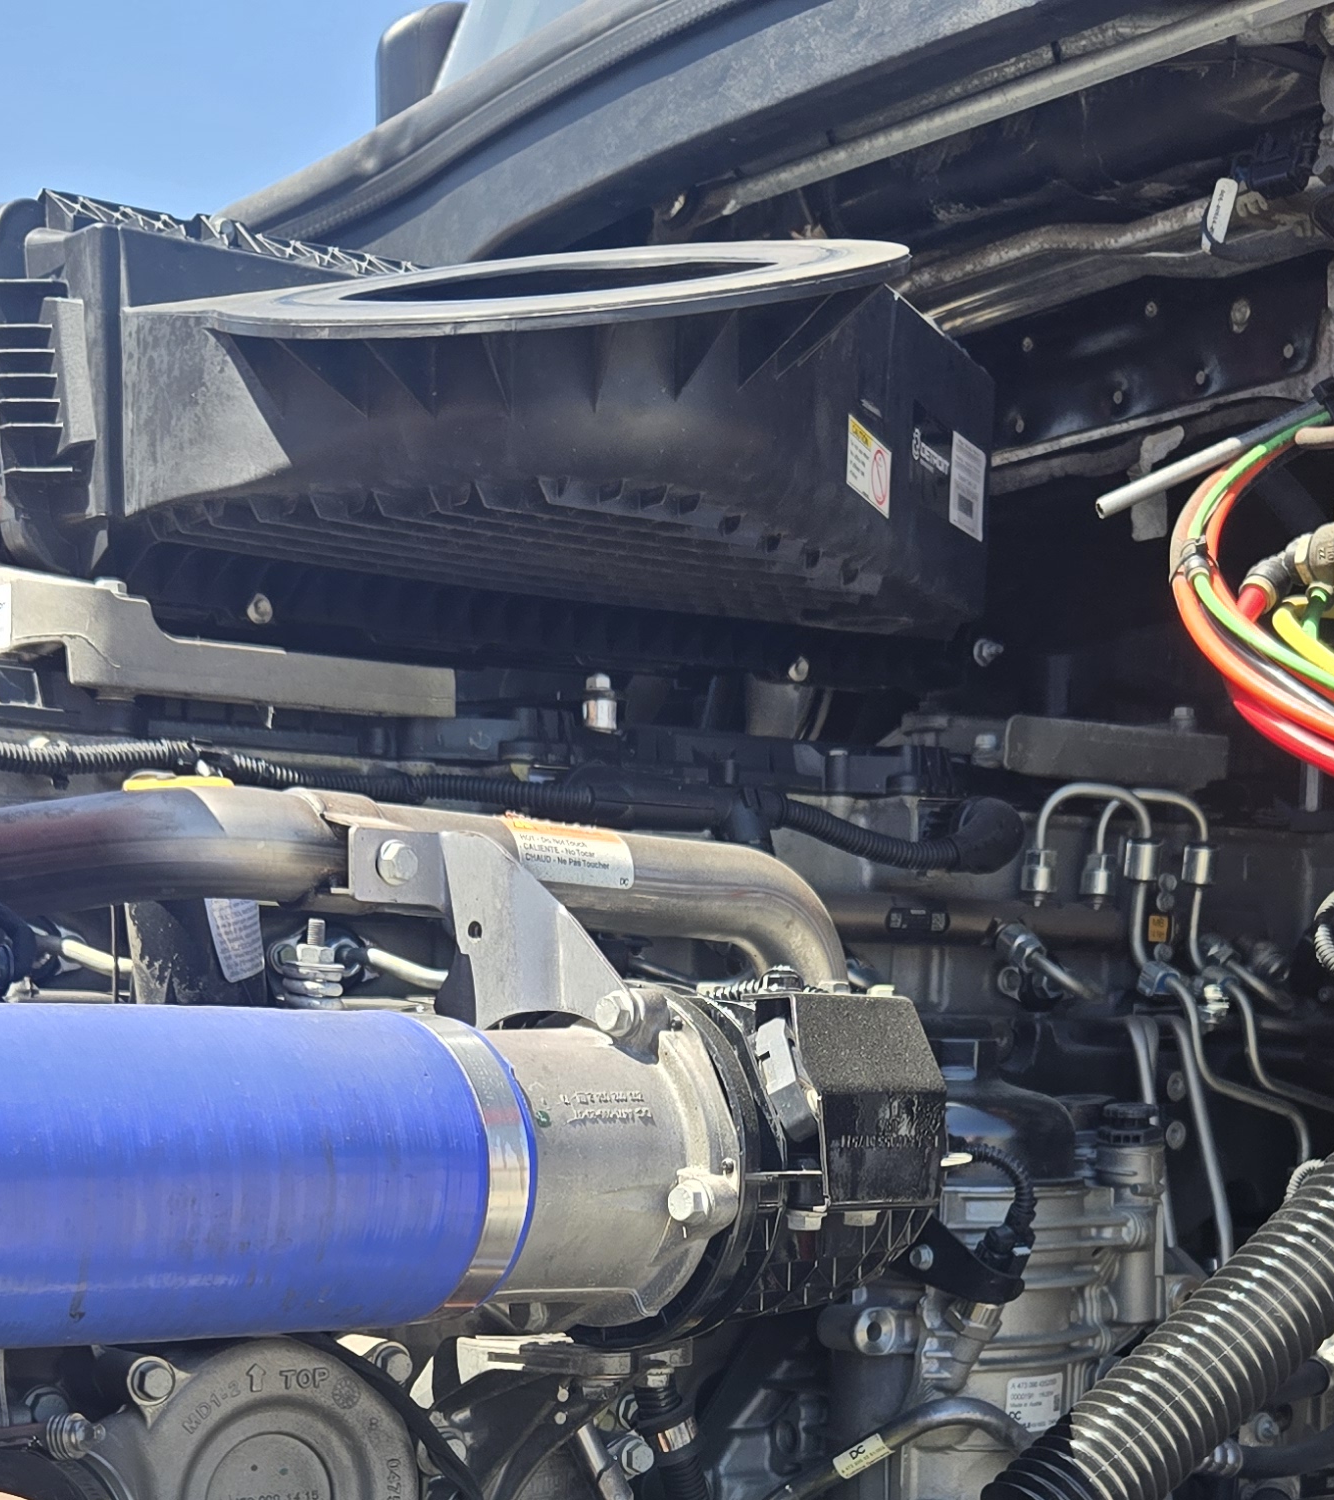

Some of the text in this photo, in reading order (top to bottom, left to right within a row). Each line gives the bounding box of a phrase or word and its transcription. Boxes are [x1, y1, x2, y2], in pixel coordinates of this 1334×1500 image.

[523, 843, 560, 854] CALIENTE
[525, 852, 552, 864] CHAUD
[558, 857, 567, 866] Ne
[583, 859, 610, 870] Toucher
[279, 1367, 330, 1391] TOP
